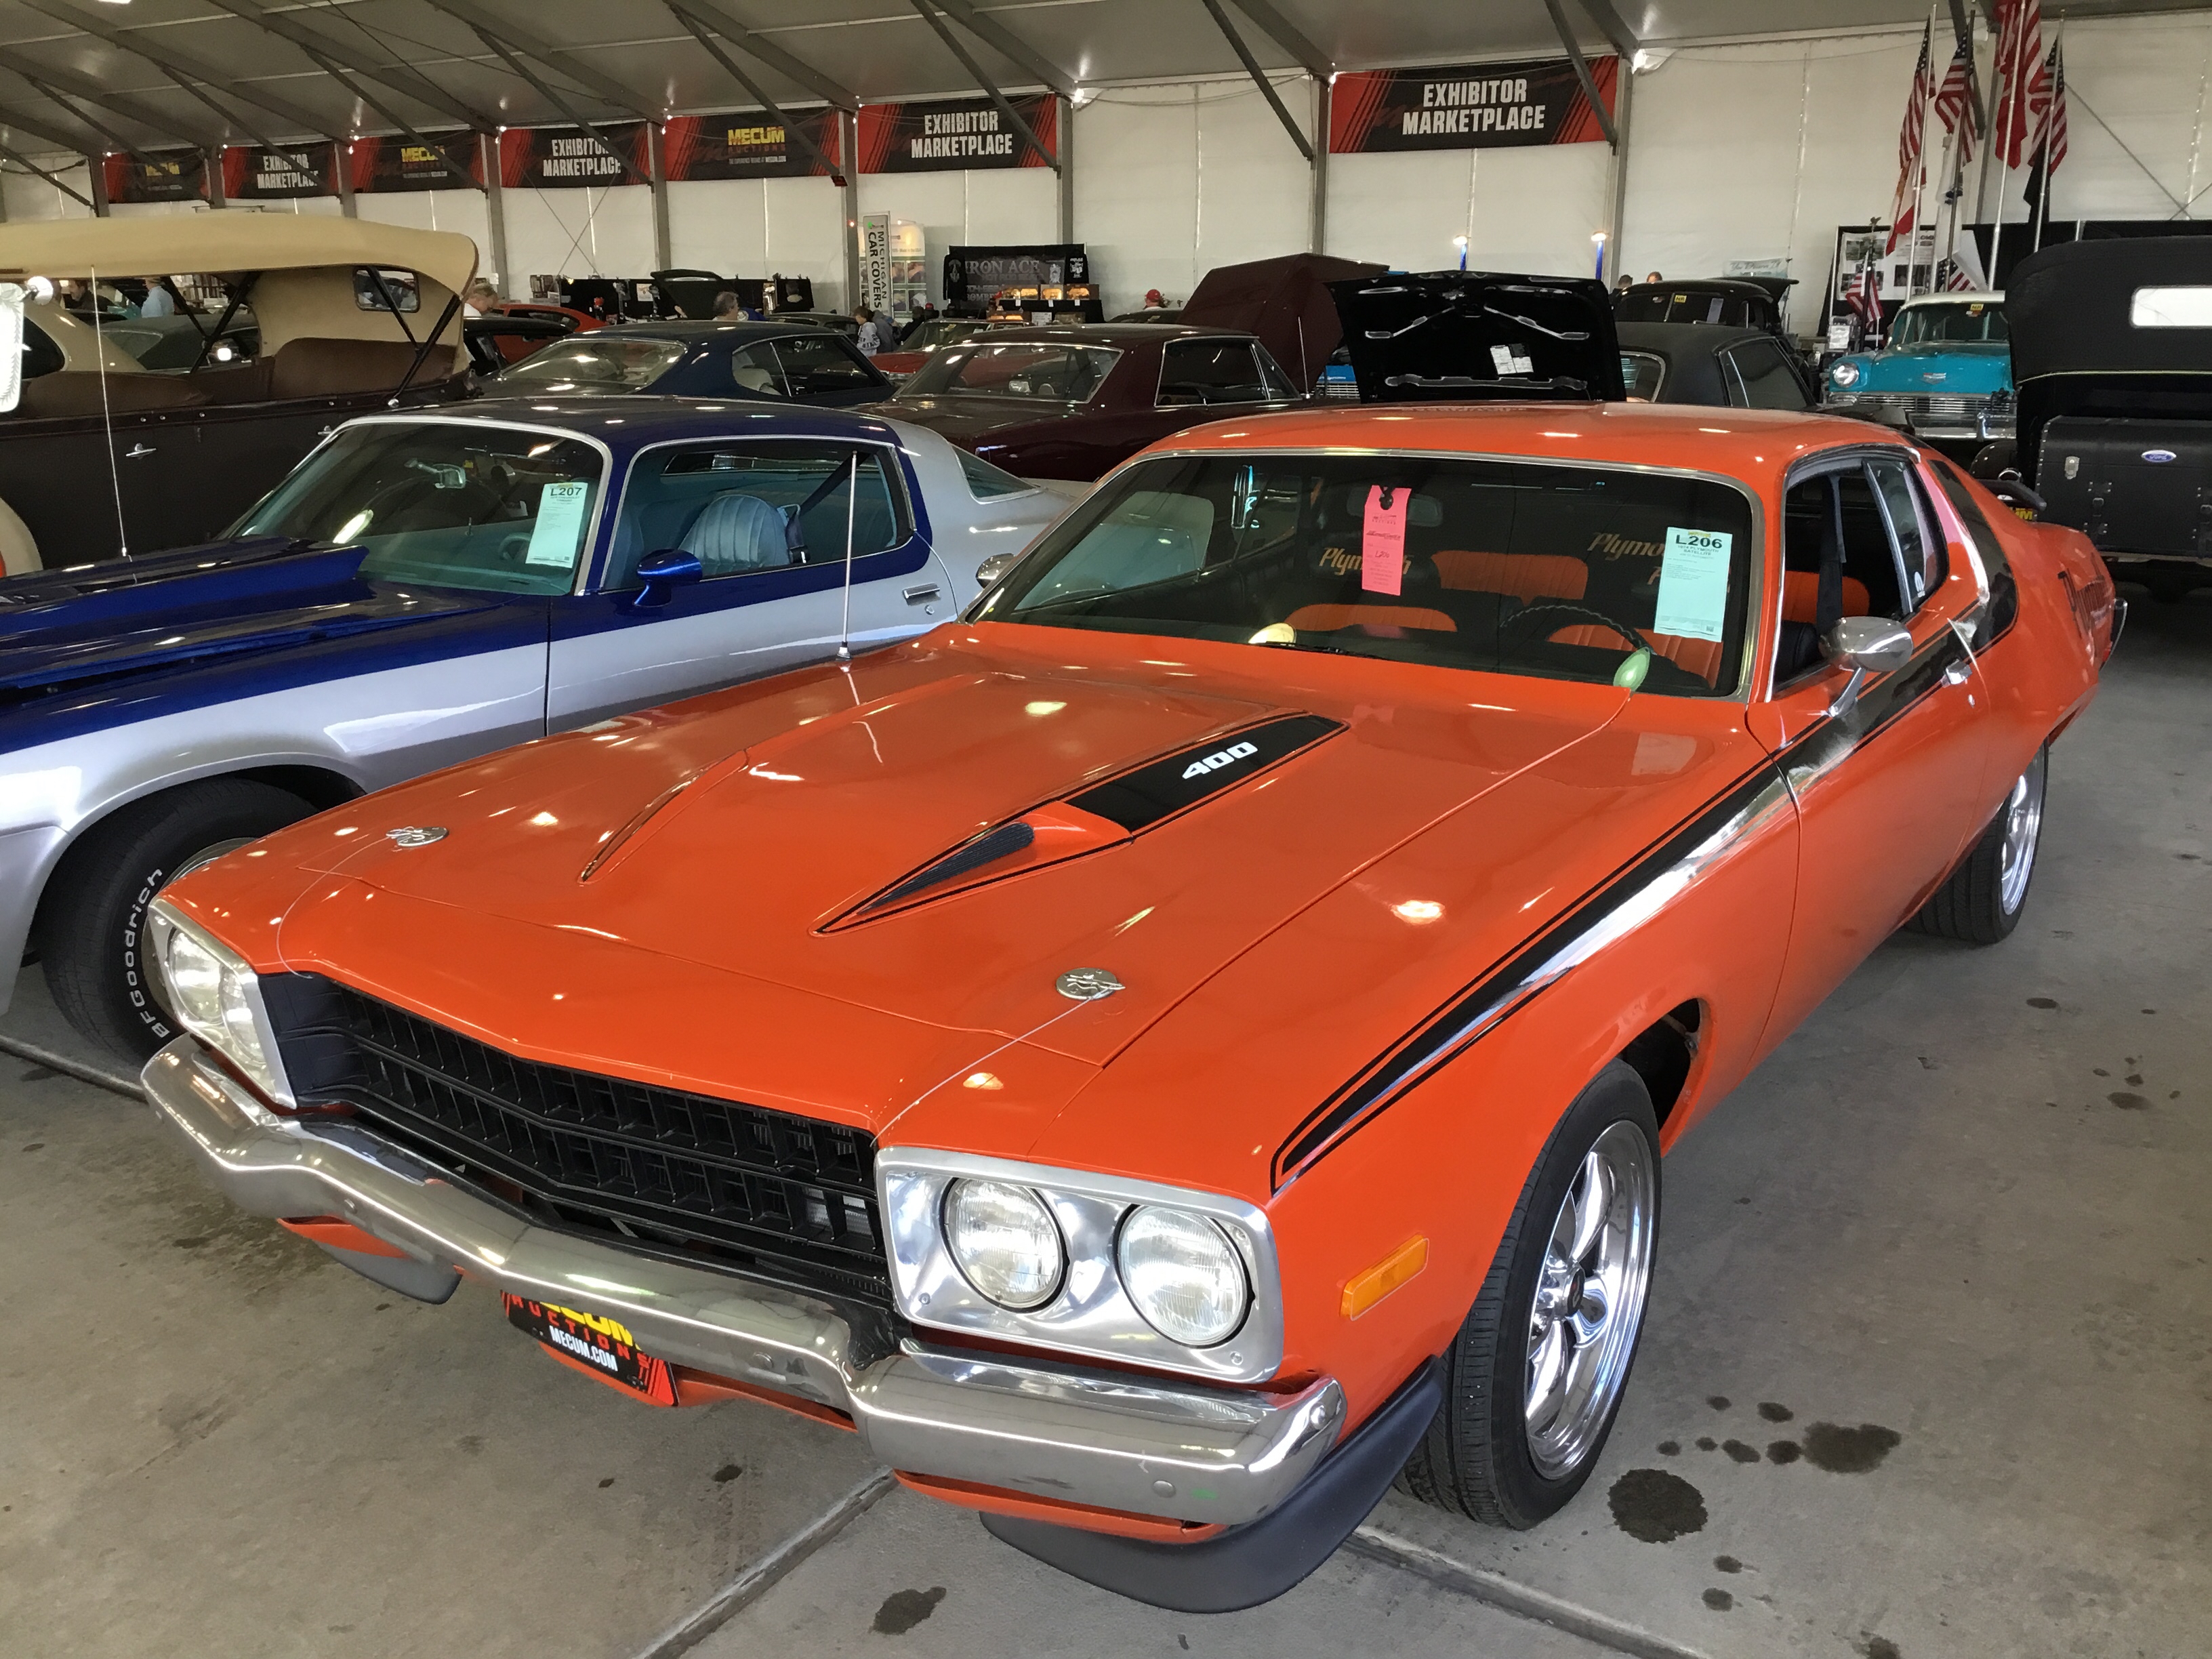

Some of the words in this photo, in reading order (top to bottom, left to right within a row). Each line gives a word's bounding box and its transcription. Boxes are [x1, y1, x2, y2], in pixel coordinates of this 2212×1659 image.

[1423, 79, 1528, 108] EXHIBITOR
[924, 110, 998, 135] EXHIBITOR
[1402, 104, 1546, 135] MARKETPLACE
[728, 126, 785, 145] MECUM
[911, 134, 1013, 159] MARKETPLACE
[257, 170, 319, 188] MARKETPLA
[543, 157, 621, 176] MARKETPLACE
[868, 231, 878, 258] CAR
[877, 231, 887, 299] MICHIGAN
[871, 260, 882, 308] COVERS
[550, 487, 582, 496] L207
[1587, 532, 1666, 561] Plymo
[1676, 535, 1723, 548] L206
[1182, 741, 1258, 779] 400
[512, 1295, 651, 1369] AUCTIONS
[549, 1325, 618, 1372] MECUM.COM
